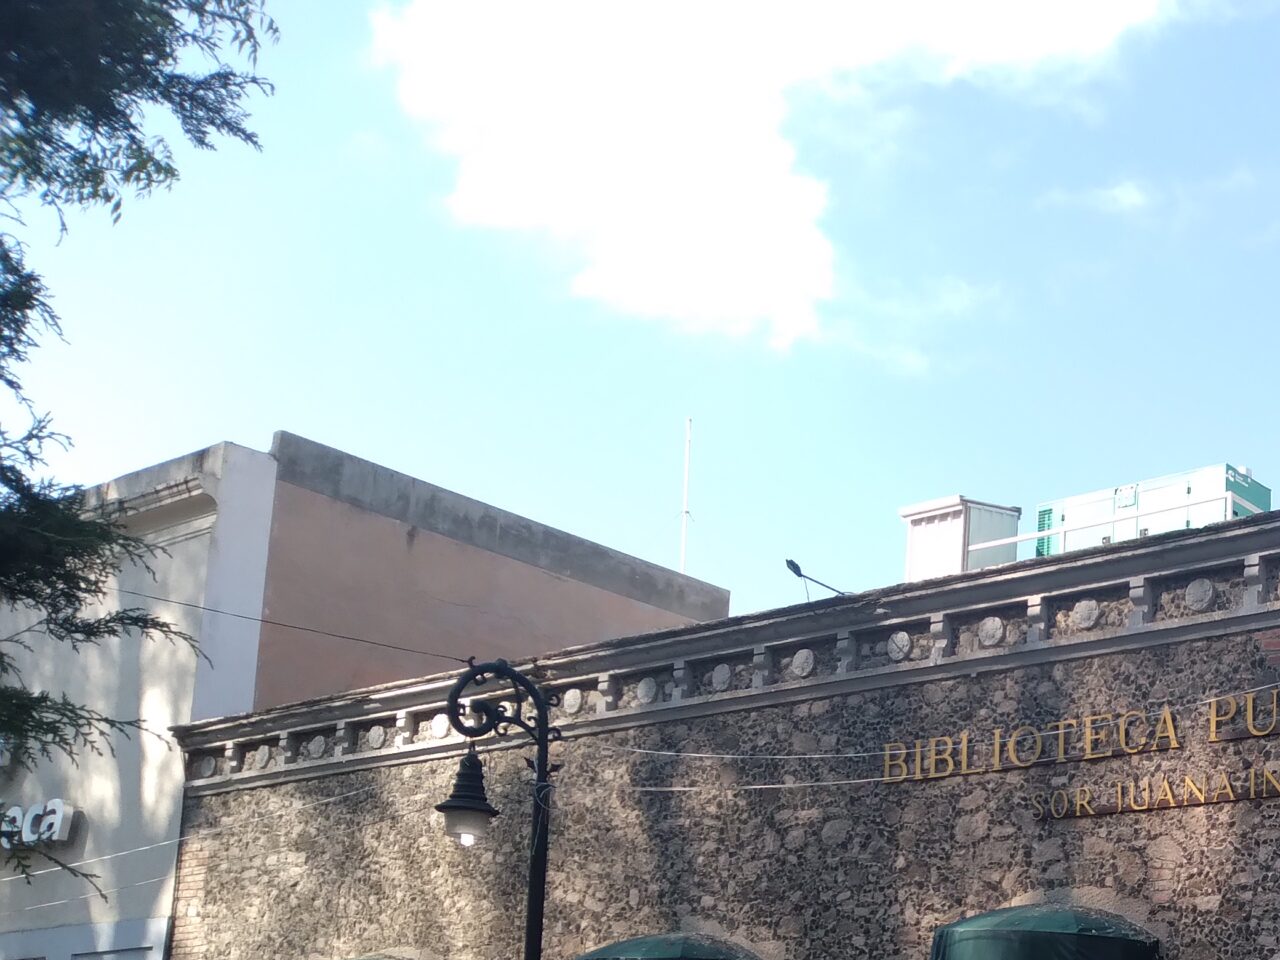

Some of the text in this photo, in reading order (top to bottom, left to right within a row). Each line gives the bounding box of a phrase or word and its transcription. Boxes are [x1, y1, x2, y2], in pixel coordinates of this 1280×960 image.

[882, 705, 1180, 783] BIBLIOTECA
[1032, 786, 1095, 820] SOR
[1117, 774, 1235, 811] JUANA
